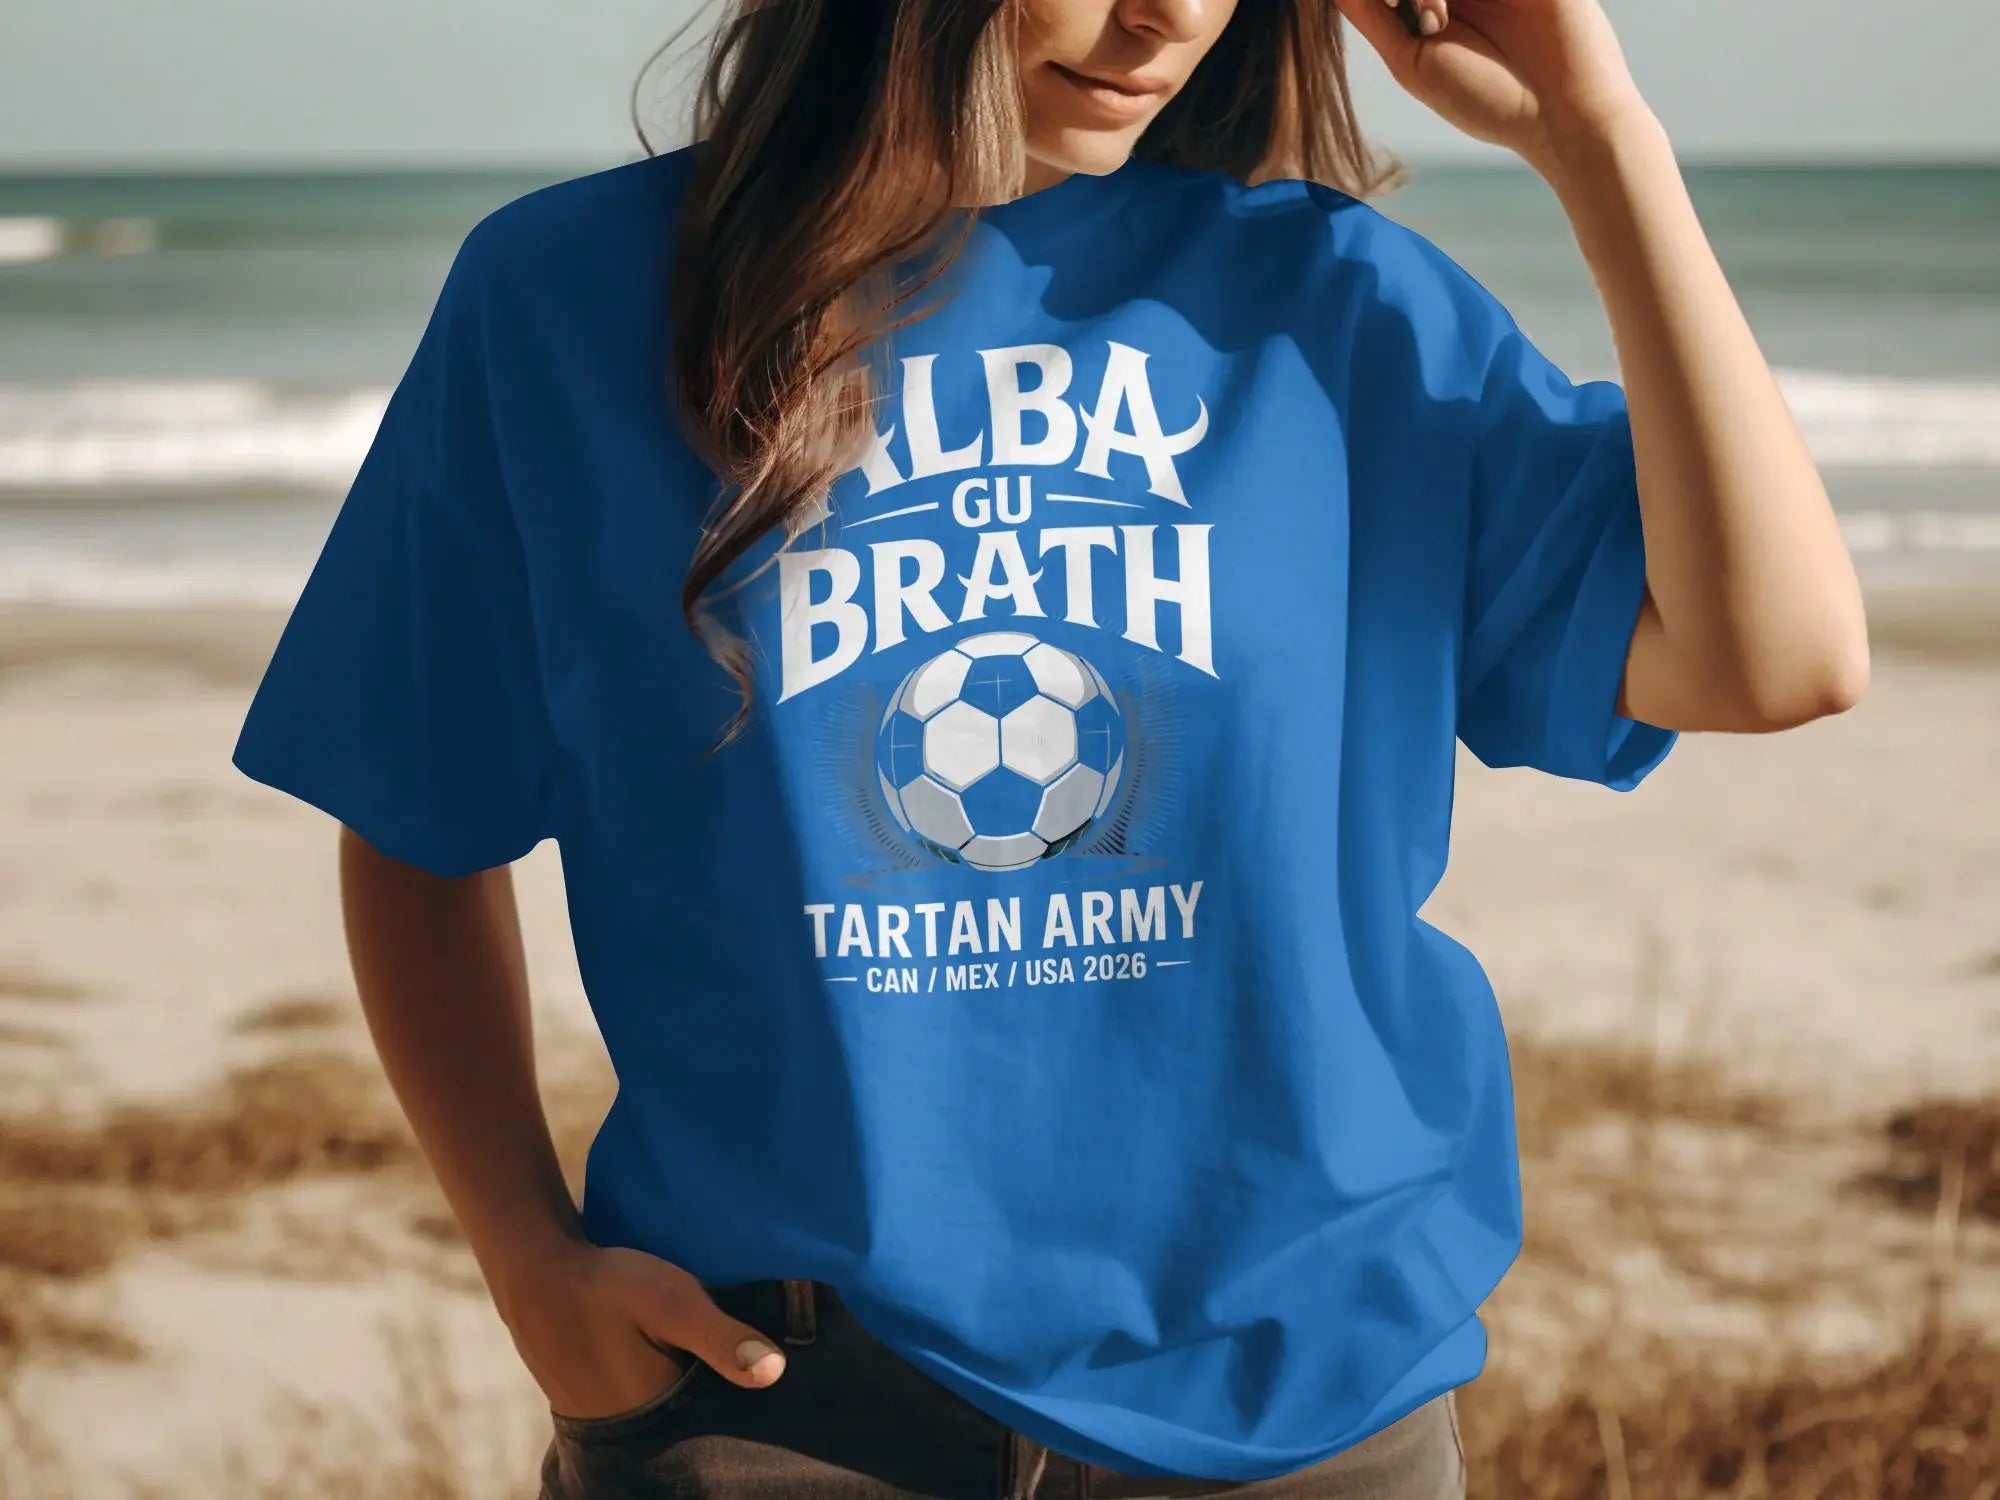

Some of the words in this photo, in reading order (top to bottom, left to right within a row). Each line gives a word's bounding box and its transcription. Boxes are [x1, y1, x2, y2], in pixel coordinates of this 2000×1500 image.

[952, 475, 1032, 527] GU
[776, 523, 1220, 705] BRATH
[804, 897, 1022, 958] TARTAN
[1042, 880, 1204, 948] ARMY
[866, 967, 918, 993] CAN
[927, 967, 937, 992] /
[945, 964, 999, 992] MEX
[1008, 963, 1018, 988] /
[1025, 958, 1075, 986] USA
[1083, 952, 1147, 981] 2026
